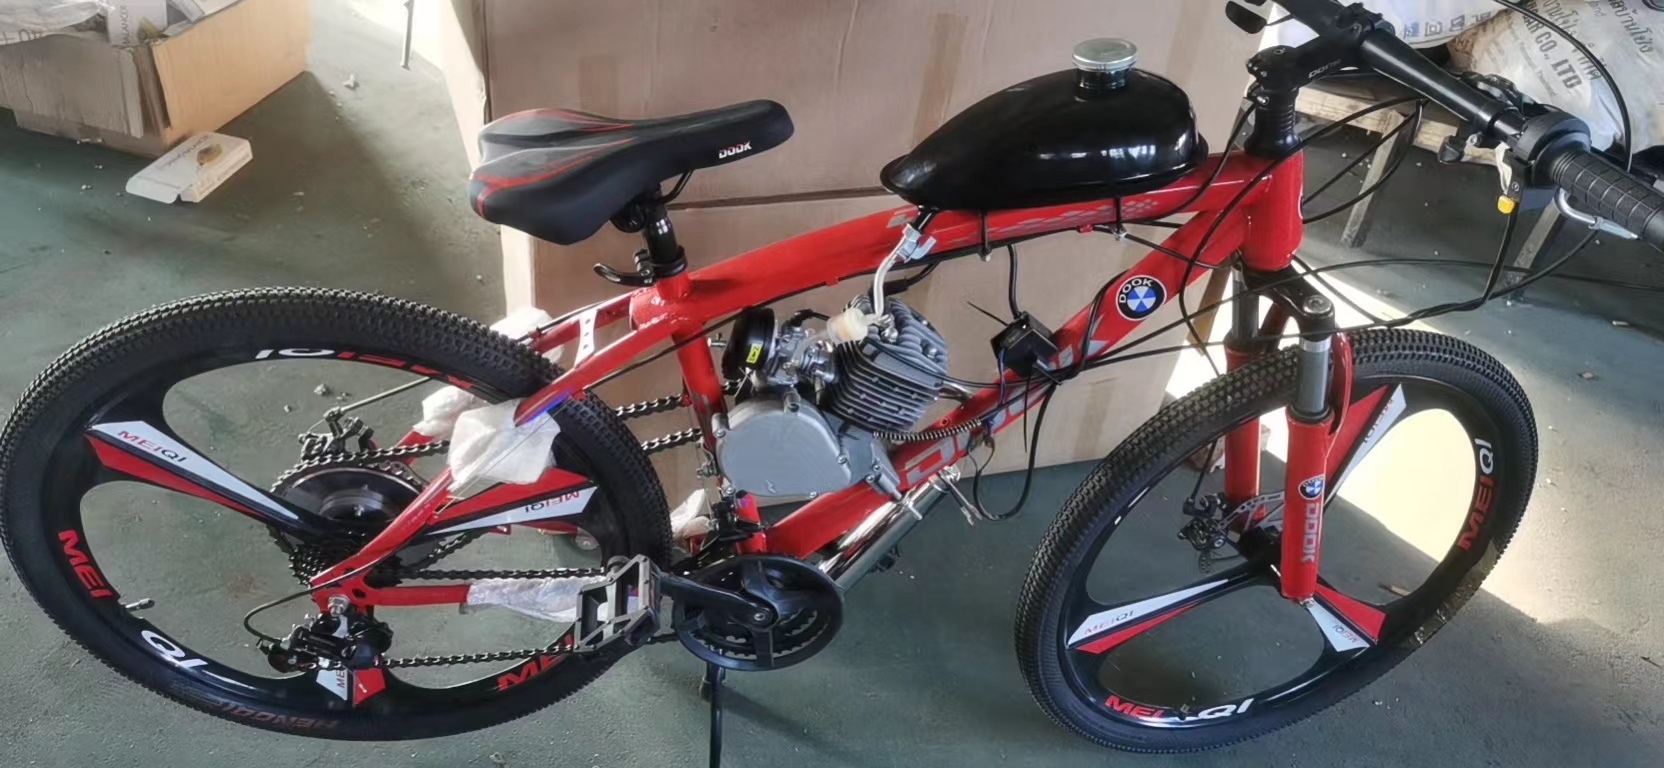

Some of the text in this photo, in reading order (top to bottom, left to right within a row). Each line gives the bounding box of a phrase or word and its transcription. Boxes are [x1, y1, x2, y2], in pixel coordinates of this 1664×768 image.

[1608, 0, 1653, 53] ลบ้านโป่ง
[1550, 58, 1583, 89] LTD
[718, 140, 753, 159] DOOK
[1119, 278, 1153, 304] DOOK
[118, 430, 188, 463] MEIQI
[524, 490, 580, 514] MEIQI
[1457, 437, 1497, 550] MEIQI
[58, 529, 209, 669] MEI QI
[1104, 695, 1255, 720] MEI QI
